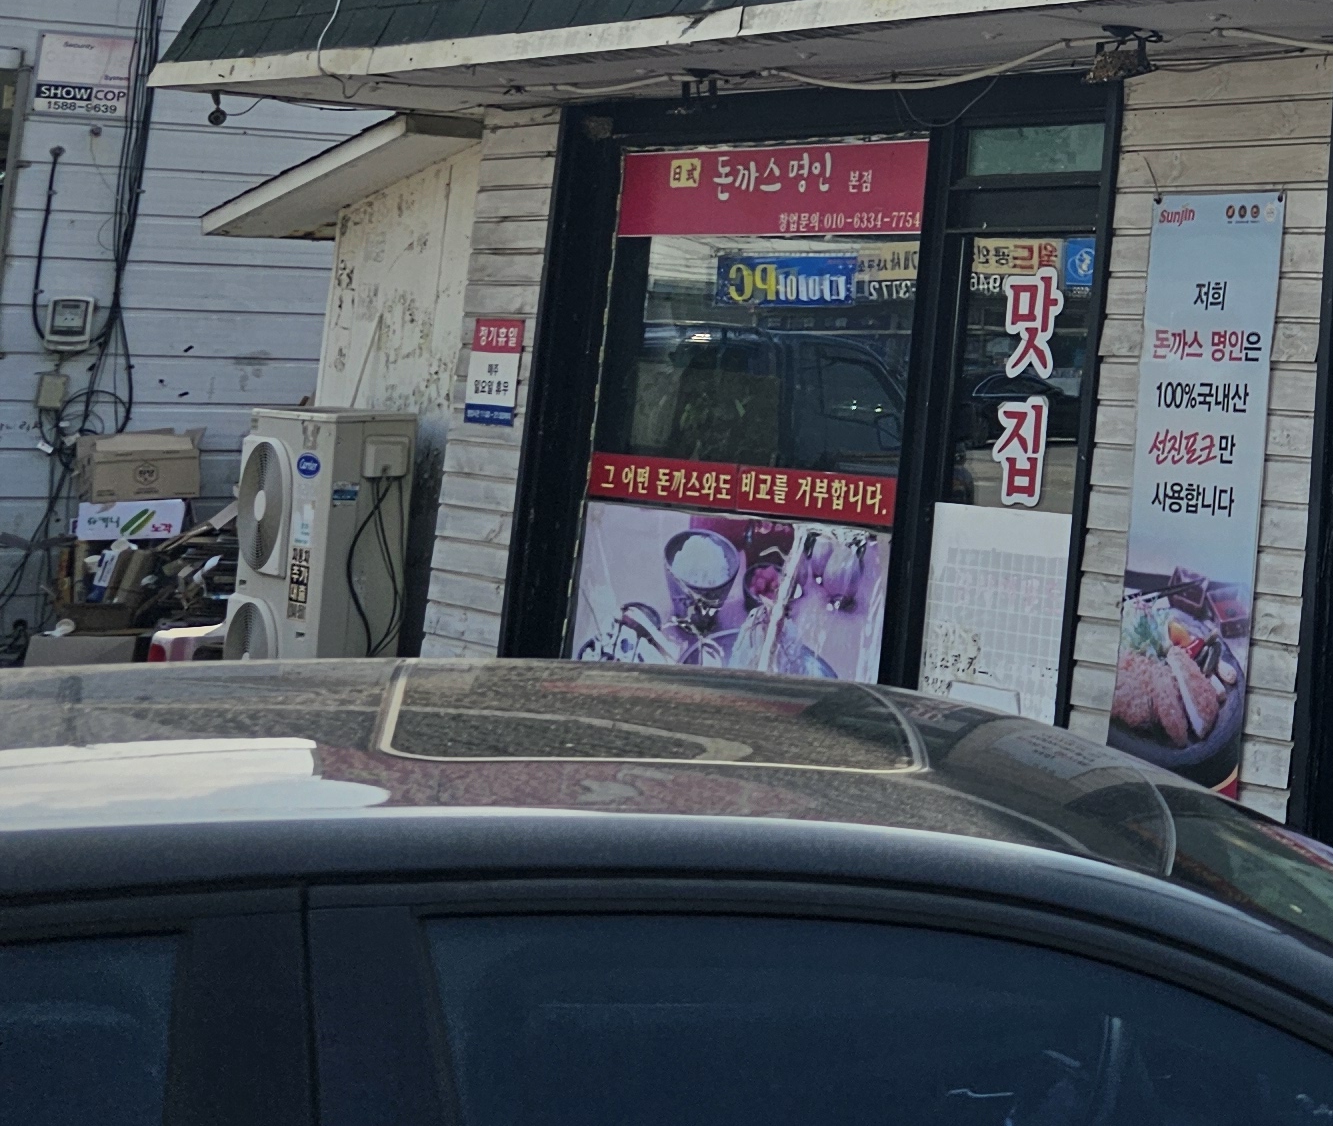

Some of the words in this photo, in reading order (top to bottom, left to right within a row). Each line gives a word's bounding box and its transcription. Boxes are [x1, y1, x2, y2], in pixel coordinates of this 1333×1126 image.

[40, 85, 91, 100] SHOW
[94, 89, 127, 102] COP
[672, 165, 698, 183] 日式
[713, 155, 781, 201] 돈까스
[788, 152, 832, 193] 명인
[848, 170, 873, 193] 본점
[1159, 207, 1195, 226] Sunjin
[1194, 281, 1228, 311] 저희
[479, 327, 518, 347] 정기휴일
[1152, 329, 1204, 360] 돈까스
[1211, 330, 1262, 362] 명인은
[1156, 382, 1250, 413] 100%국내산
[1149, 429, 1236, 465] 선진포크만
[601, 466, 615, 488] 그
[622, 465, 650, 494] 어떤
[656, 466, 731, 501] 돈까스와도
[741, 471, 789, 503] 비교를
[796, 477, 887, 515] 거부합니다.
[1151, 481, 1235, 517] 사용합니다
